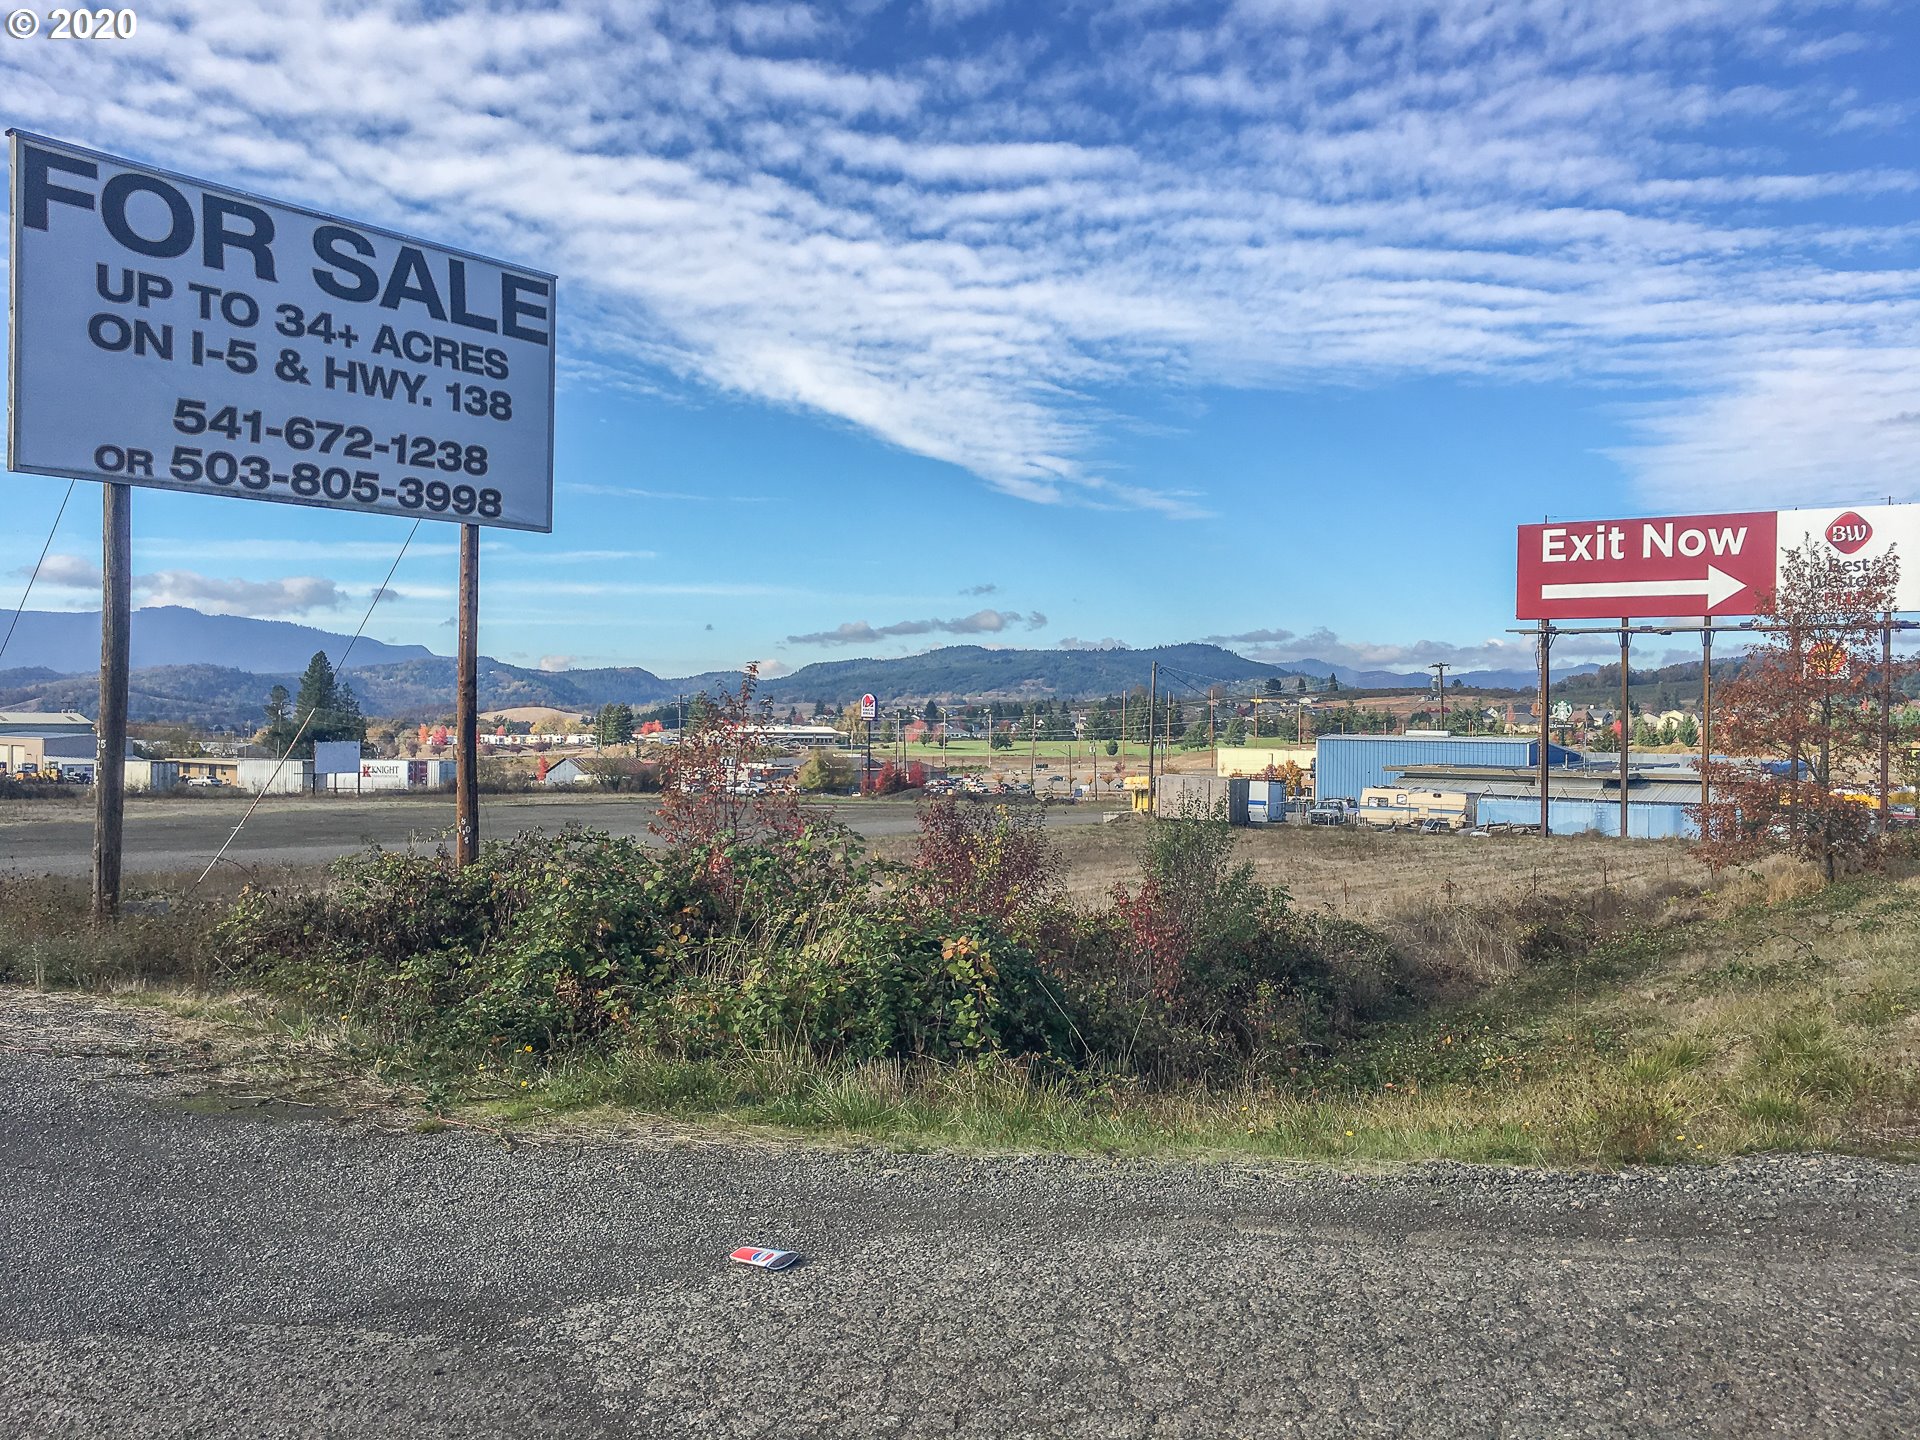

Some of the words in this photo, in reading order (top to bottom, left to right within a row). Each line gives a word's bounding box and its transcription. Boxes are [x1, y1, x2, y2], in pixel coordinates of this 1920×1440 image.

[23, 145, 279, 283] FOR
[312, 225, 549, 346] SALE
[96, 262, 174, 308] UP
[188, 282, 260, 328] TO
[275, 303, 359, 349] 34+
[371, 323, 509, 380] ACRES
[88, 312, 174, 361] ON
[192, 330, 258, 375] I-5
[275, 349, 312, 386] &
[325, 355, 432, 408] HWY.
[446, 382, 512, 421] 138
[172, 397, 489, 477] 541-672-1238
[93, 443, 155, 477] OR
[169, 445, 503, 518] 503-805-3998
[1542, 524, 1625, 563] Exit
[1642, 522, 1748, 559] Now
[1828, 558, 1871, 573] Best
[1832, 524, 1867, 542] BW
[371, 765, 399, 774] KNIGHT
